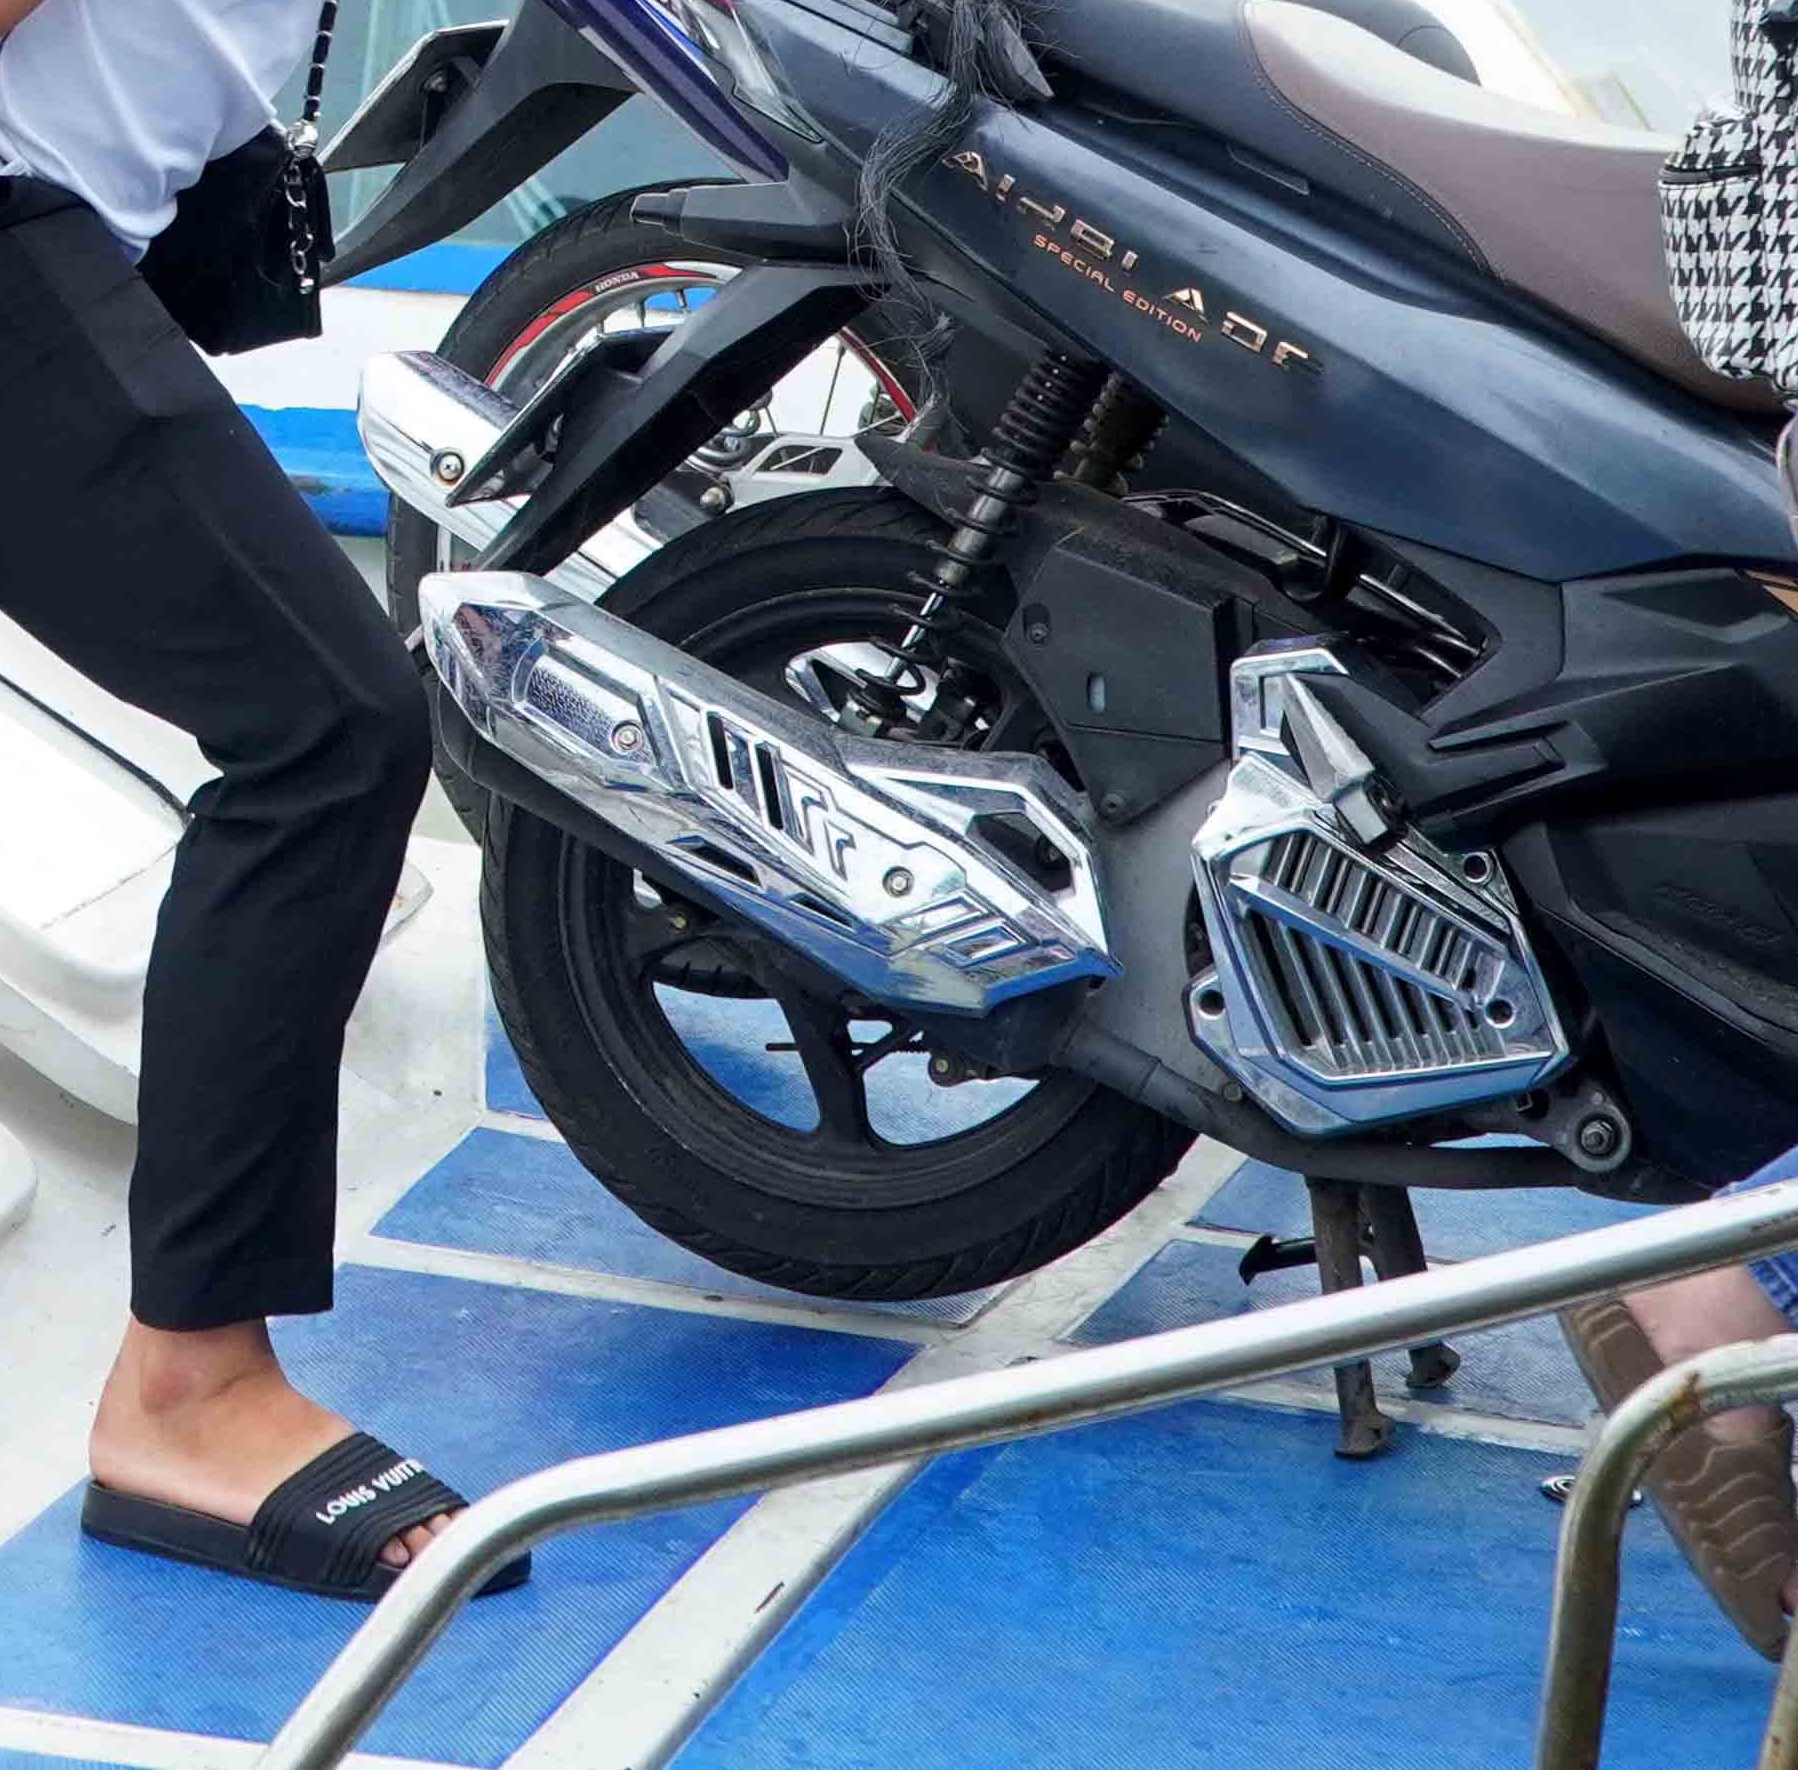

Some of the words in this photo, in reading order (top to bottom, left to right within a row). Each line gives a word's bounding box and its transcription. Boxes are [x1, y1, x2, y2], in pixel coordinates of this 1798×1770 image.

[594, 271, 640, 293] HONDA
[1032, 232, 1116, 293] SPECIAL
[1123, 288, 1203, 343] EDITION
[315, 1485, 377, 1525] LOUIS
